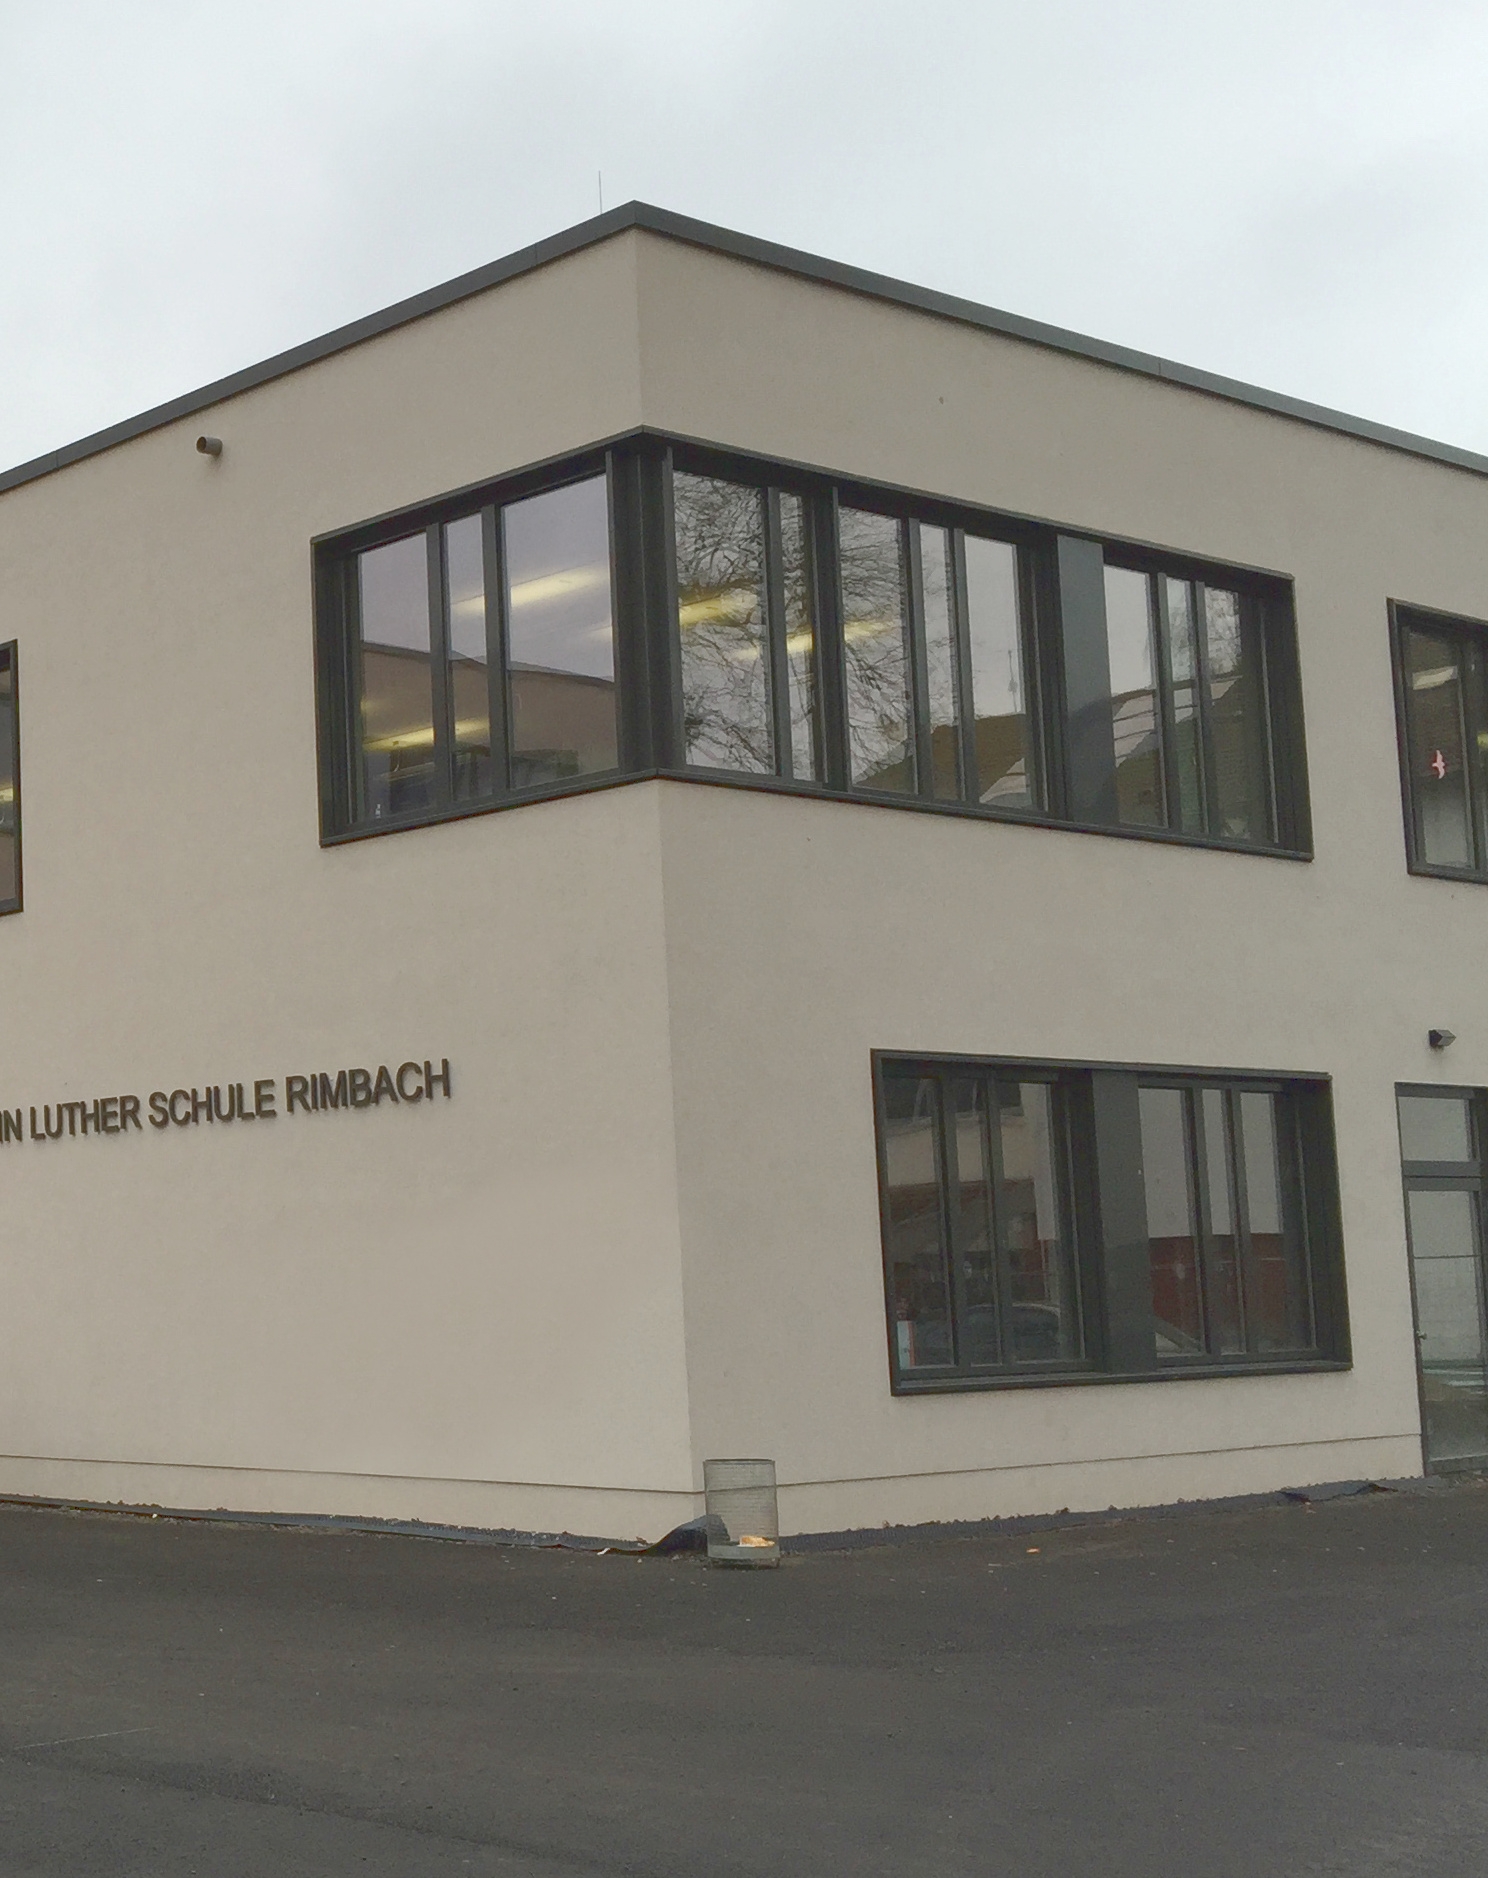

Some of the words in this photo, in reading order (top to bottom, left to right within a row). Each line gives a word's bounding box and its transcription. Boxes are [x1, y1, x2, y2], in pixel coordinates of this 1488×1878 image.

[29, 1095, 141, 1142] LUTHER
[147, 1079, 277, 1129] SCHULE
[285, 1058, 452, 1114] RIMBACH
